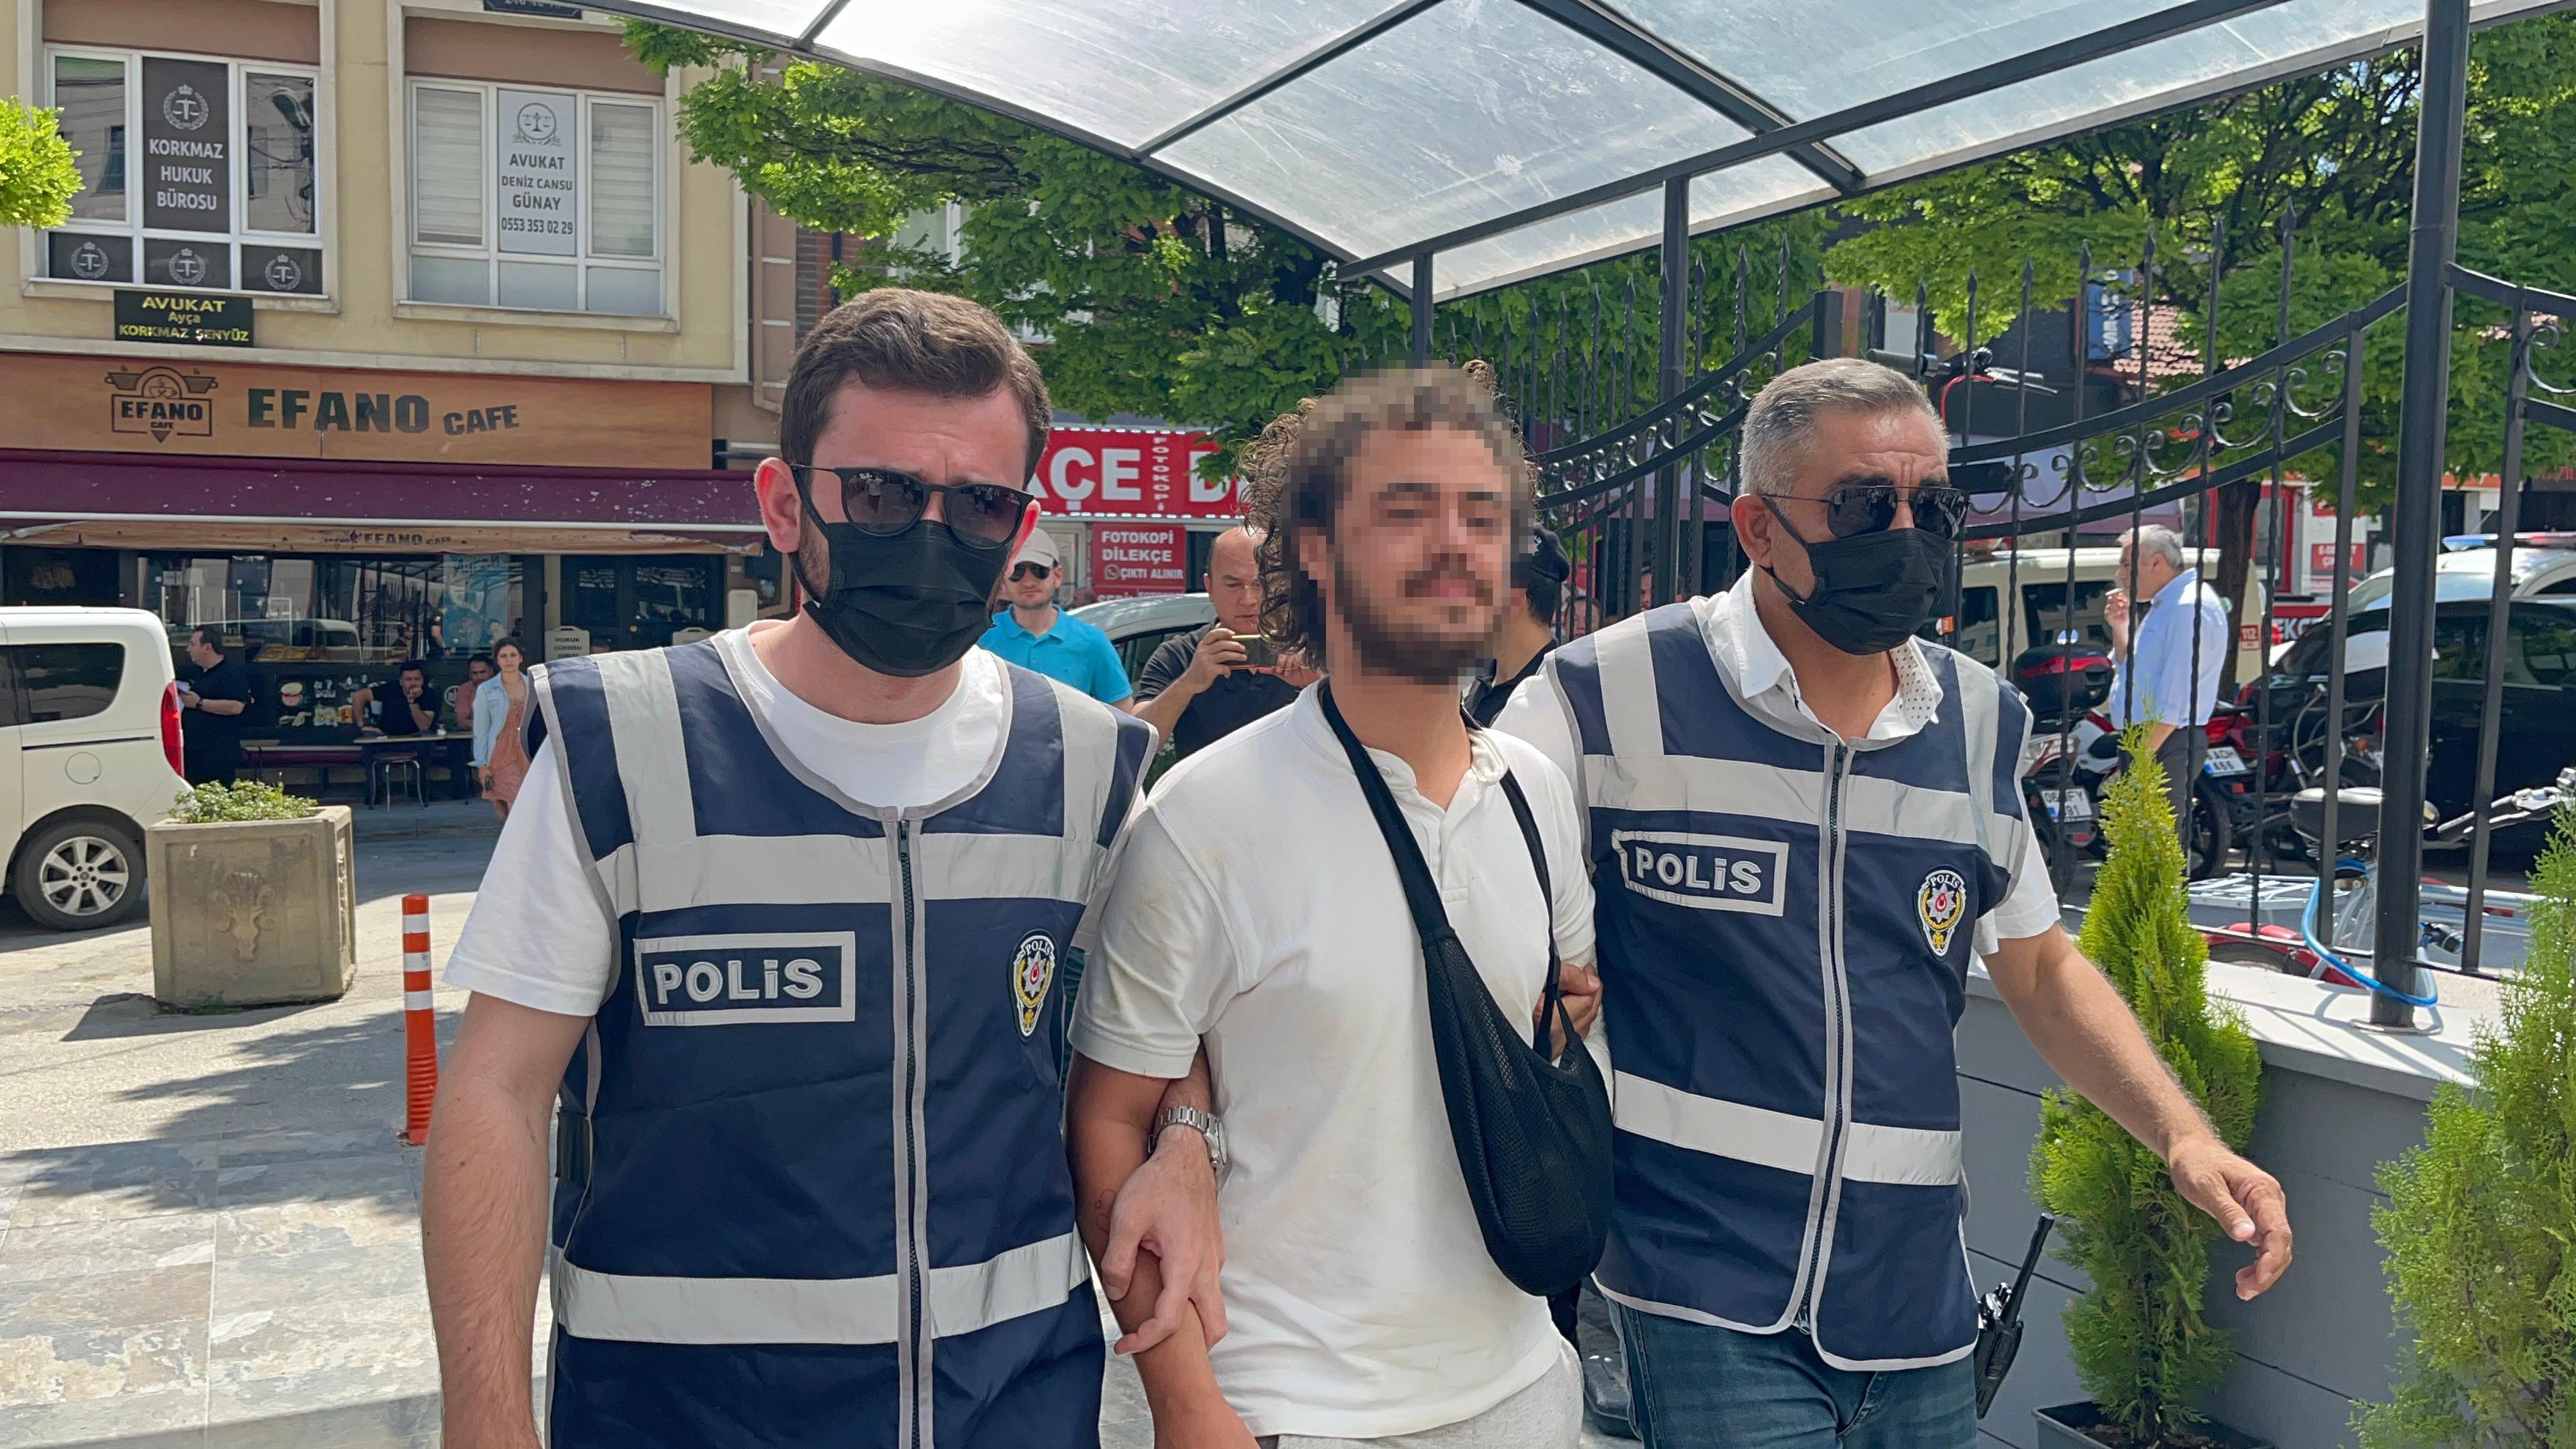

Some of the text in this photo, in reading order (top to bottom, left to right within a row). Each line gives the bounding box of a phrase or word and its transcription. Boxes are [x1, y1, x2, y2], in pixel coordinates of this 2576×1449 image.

[149, 138, 223, 159] KORKMAZ
[509, 154, 565, 169] AVUKAT
[161, 165, 212, 184] HUKUK
[501, 175, 572, 190] DENİZ CANSU
[157, 188, 217, 210] BÜROSU
[512, 191, 561, 211] GÜNAY
[501, 217, 573, 234] 0553 353 02 29
[142, 296, 226, 312] AVUKAT
[168, 312, 201, 325] Ayça
[119, 324, 249, 342] KORKMAZ ŞENYÜZ
[121, 400, 203, 421] EFANO
[247, 388, 520, 435] EFANO CAFE
[1101, 530, 1174, 544] FOTOKOPİ
[1102, 546, 1173, 565] DİLEKÇE
[1120, 567, 1183, 580] ÇIKTI ALINIR
